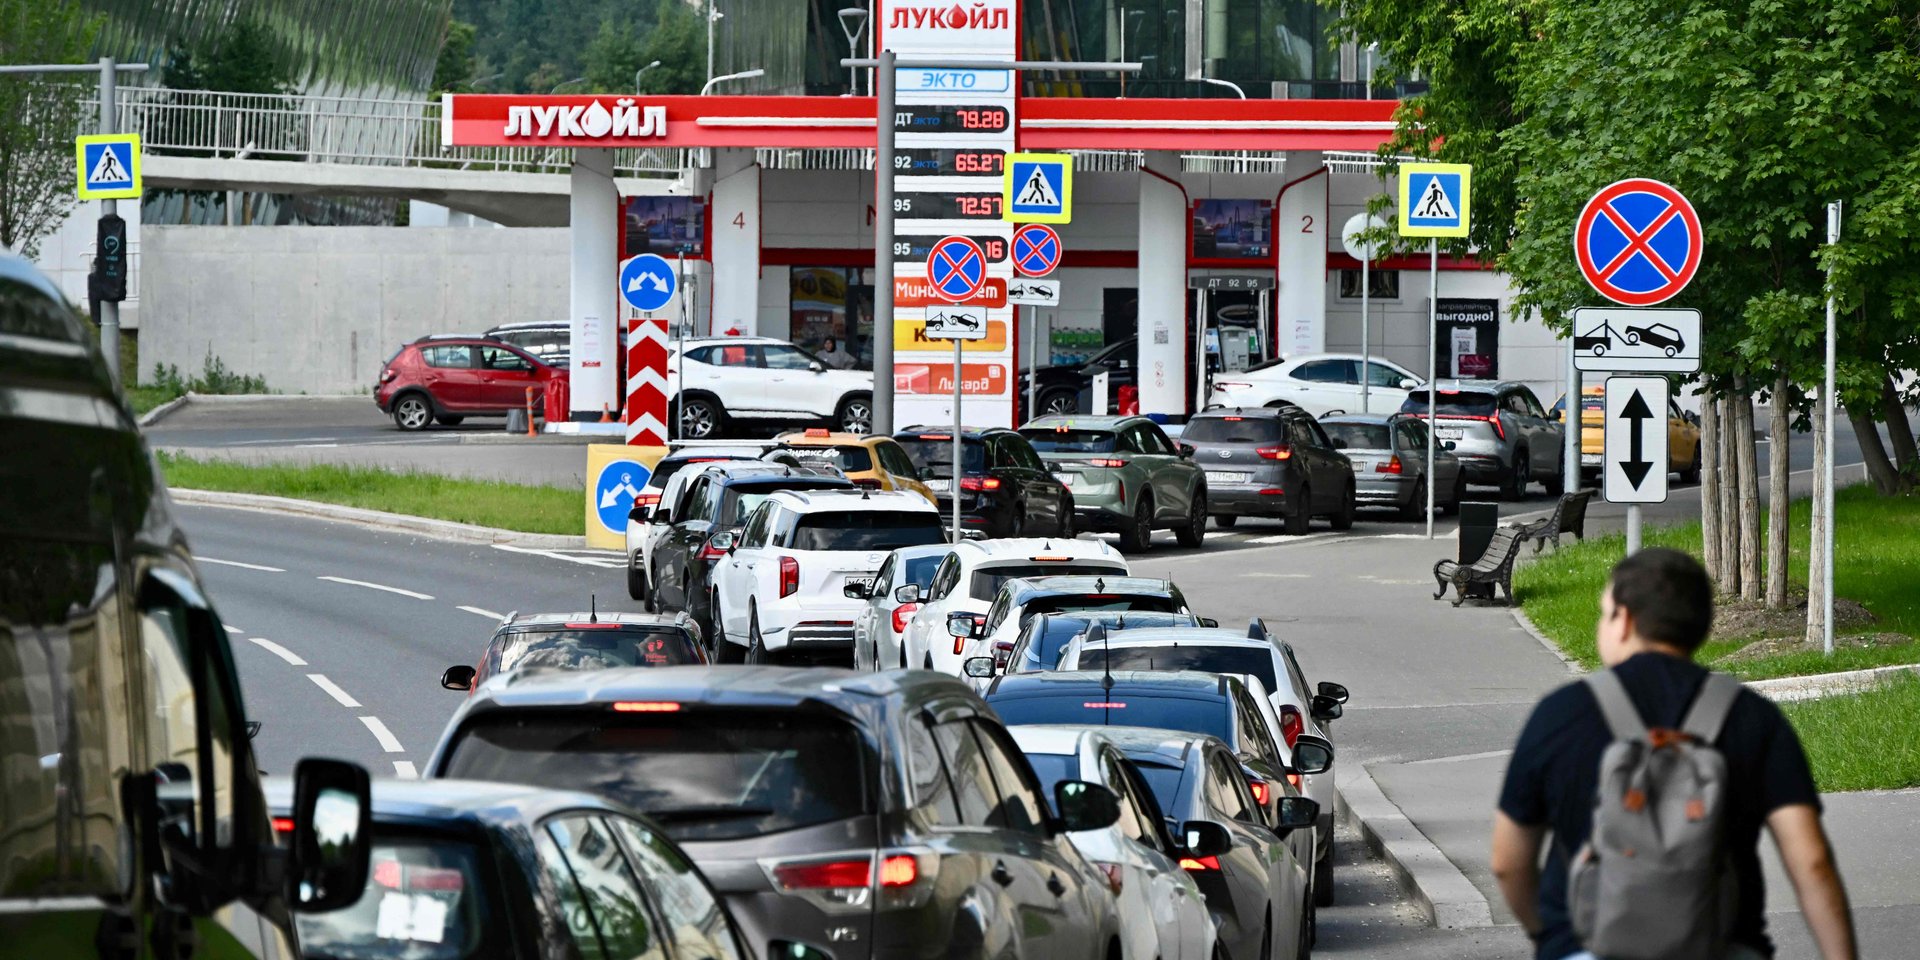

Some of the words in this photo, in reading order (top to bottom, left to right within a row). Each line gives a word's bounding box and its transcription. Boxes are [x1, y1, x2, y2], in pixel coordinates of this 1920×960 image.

[890, 3, 1008, 30] ЛУКОЙЛ
[921, 72, 976, 88] ЭКТО
[503, 98, 667, 138] ЛУКОЙЛ
[895, 112, 914, 127] ДТ
[914, 117, 940, 125] ЭКТО
[957, 110, 1004, 129] 79.28
[895, 156, 911, 169] 92
[955, 154, 1004, 172] 65.27
[894, 199, 911, 211] 95
[956, 197, 1003, 215] 72.57
[733, 212, 746, 230] 4
[1301, 215, 1313, 233] 2
[894, 242, 911, 255] 95
[912, 248, 930, 256] ЭКТ
[986, 241, 1003, 258] 16
[895, 282, 998, 299] Миниет
[1208, 278, 1221, 288] ДТ
[1228, 278, 1240, 287] 92
[1247, 278, 1258, 288] 95
[1436, 311, 1494, 323] выгодно!
